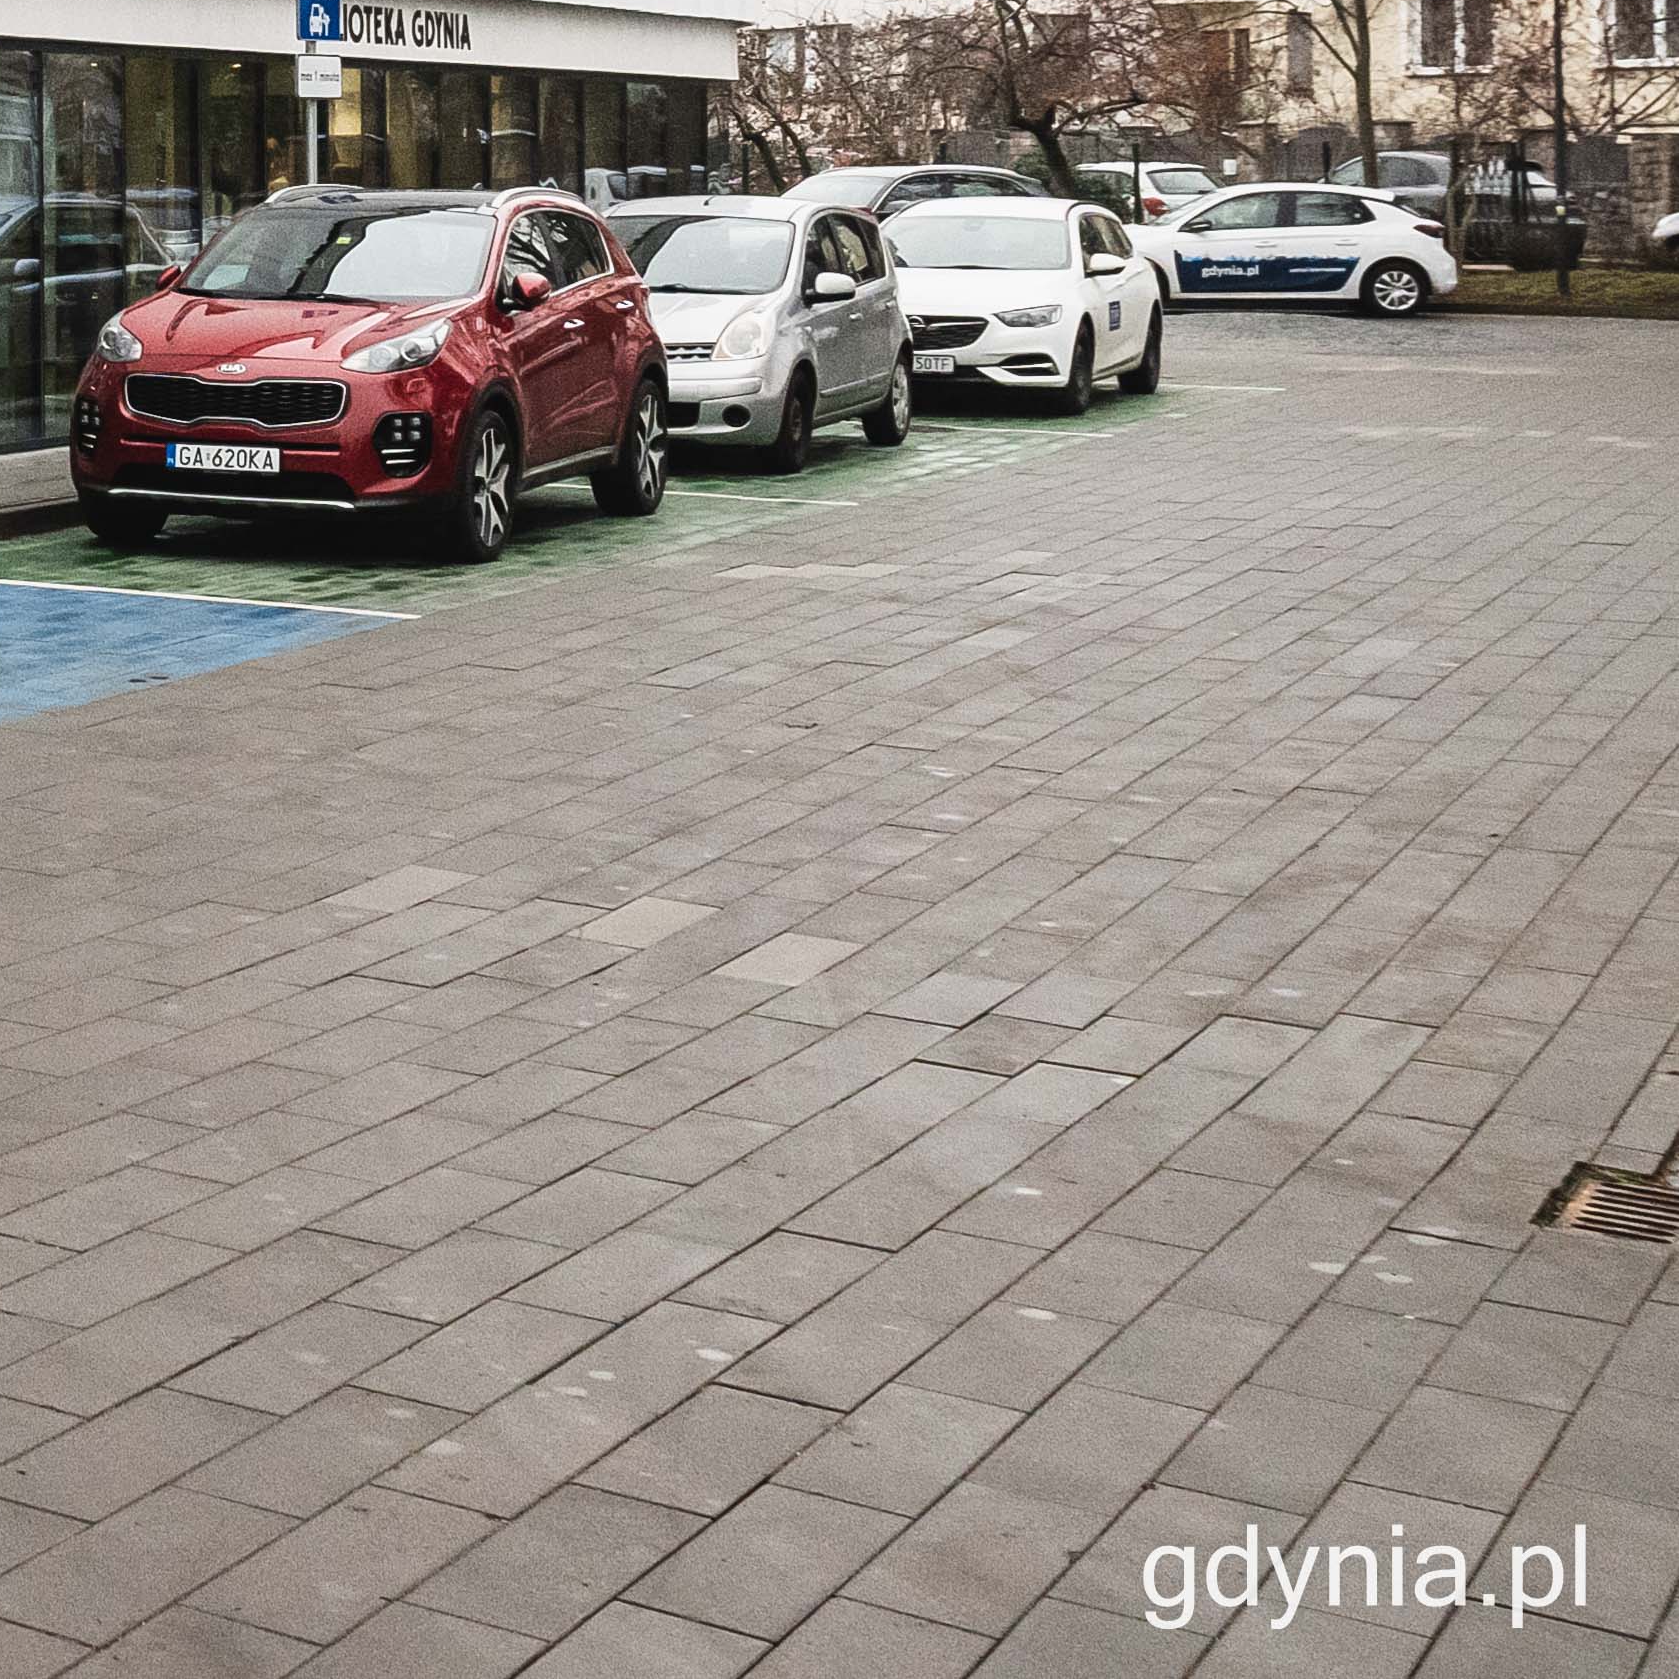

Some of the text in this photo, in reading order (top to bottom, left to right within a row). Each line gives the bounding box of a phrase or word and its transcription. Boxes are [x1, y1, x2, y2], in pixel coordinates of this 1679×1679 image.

[341, 3, 471, 50] IOTEKA GDYNIA
[1202, 265, 1259, 278] gdynia.pl
[179, 447, 274, 470] GA 620KA
